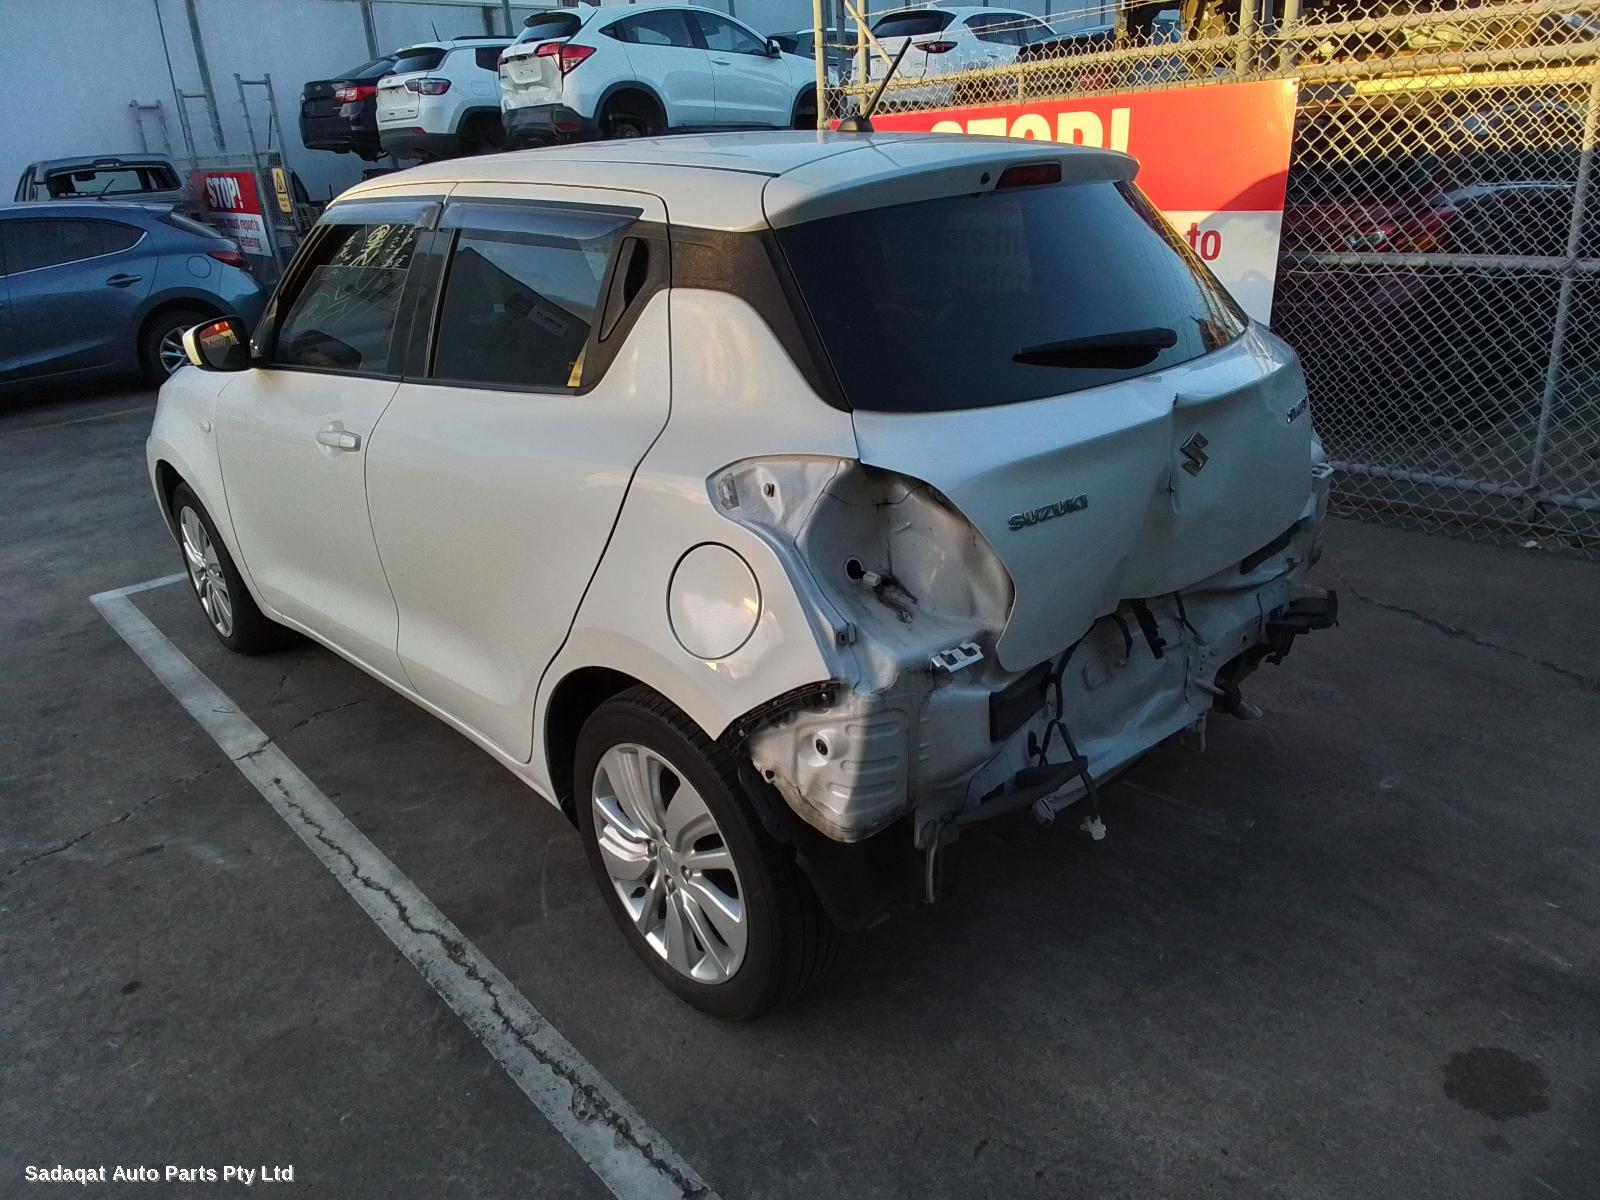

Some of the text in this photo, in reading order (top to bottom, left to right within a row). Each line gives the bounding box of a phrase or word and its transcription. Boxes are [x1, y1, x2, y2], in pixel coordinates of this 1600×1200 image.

[206, 177, 244, 209] STOP!
[1187, 223, 1221, 260] to
[1008, 493, 1088, 531] SUZUKI
